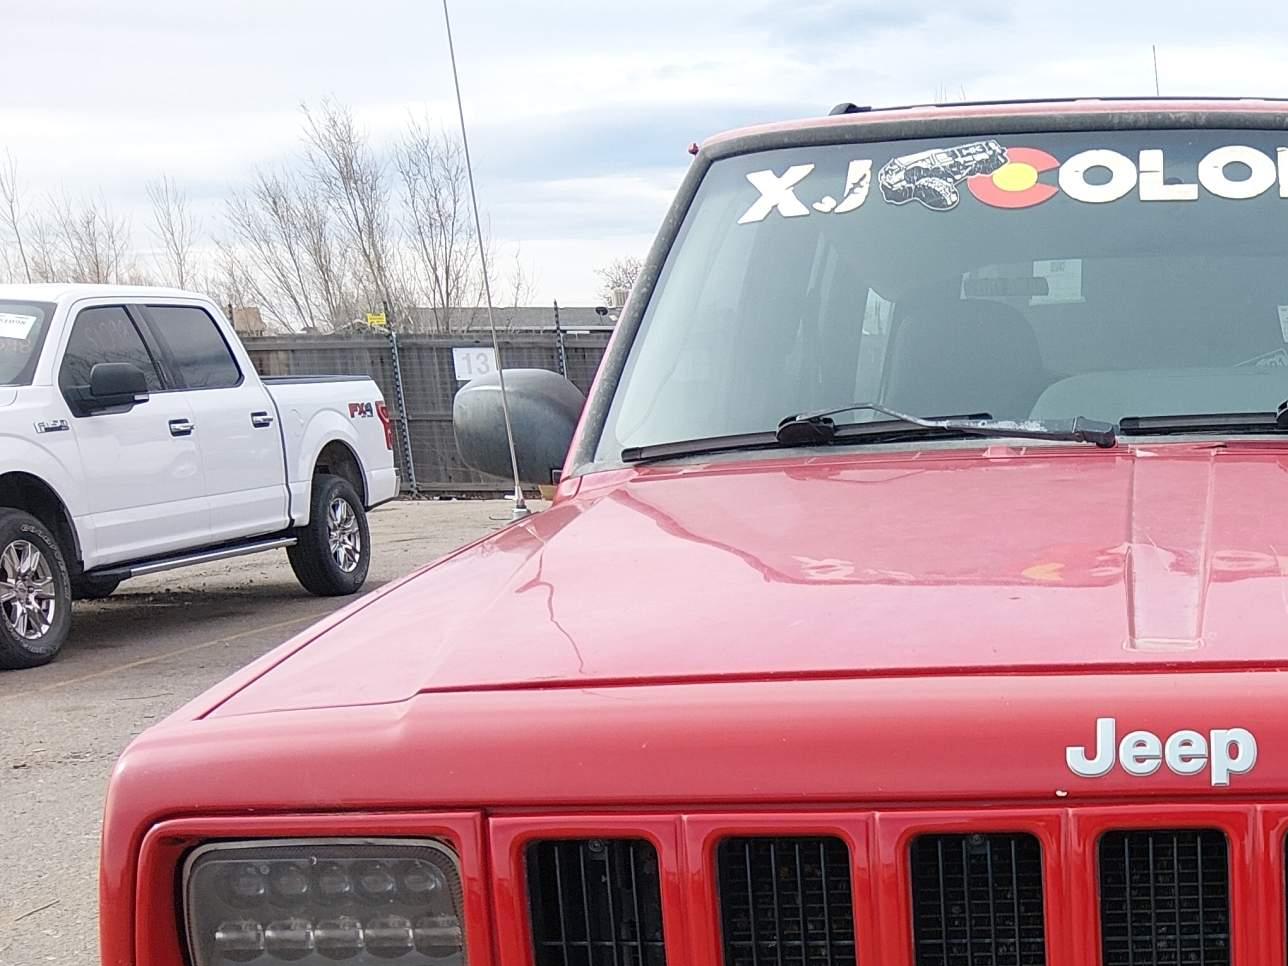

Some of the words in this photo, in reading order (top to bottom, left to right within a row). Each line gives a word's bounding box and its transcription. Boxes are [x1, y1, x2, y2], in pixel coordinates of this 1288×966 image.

[737, 160, 872, 224] XJ
[461, 352, 491, 375] 13
[348, 402, 374, 418] FX4
[1065, 717, 1258, 787] Jeep
